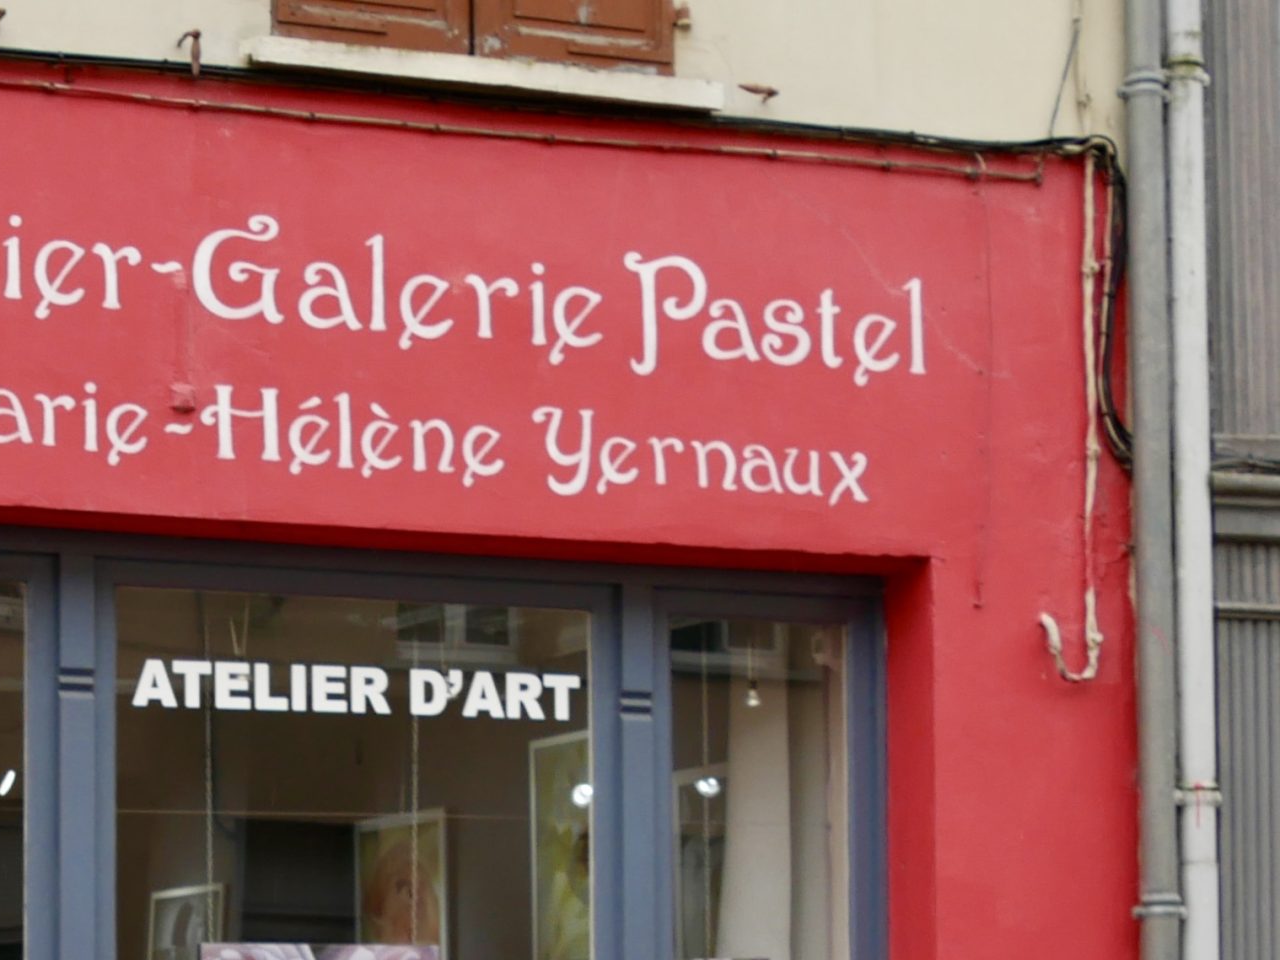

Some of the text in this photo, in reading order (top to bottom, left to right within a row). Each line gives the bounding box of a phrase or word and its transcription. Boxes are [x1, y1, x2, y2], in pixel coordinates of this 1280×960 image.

[623, 250, 926, 386] Pastel
[532, 405, 869, 506] Yernaux
[132, 659, 580, 721] ATELIER D'ART
